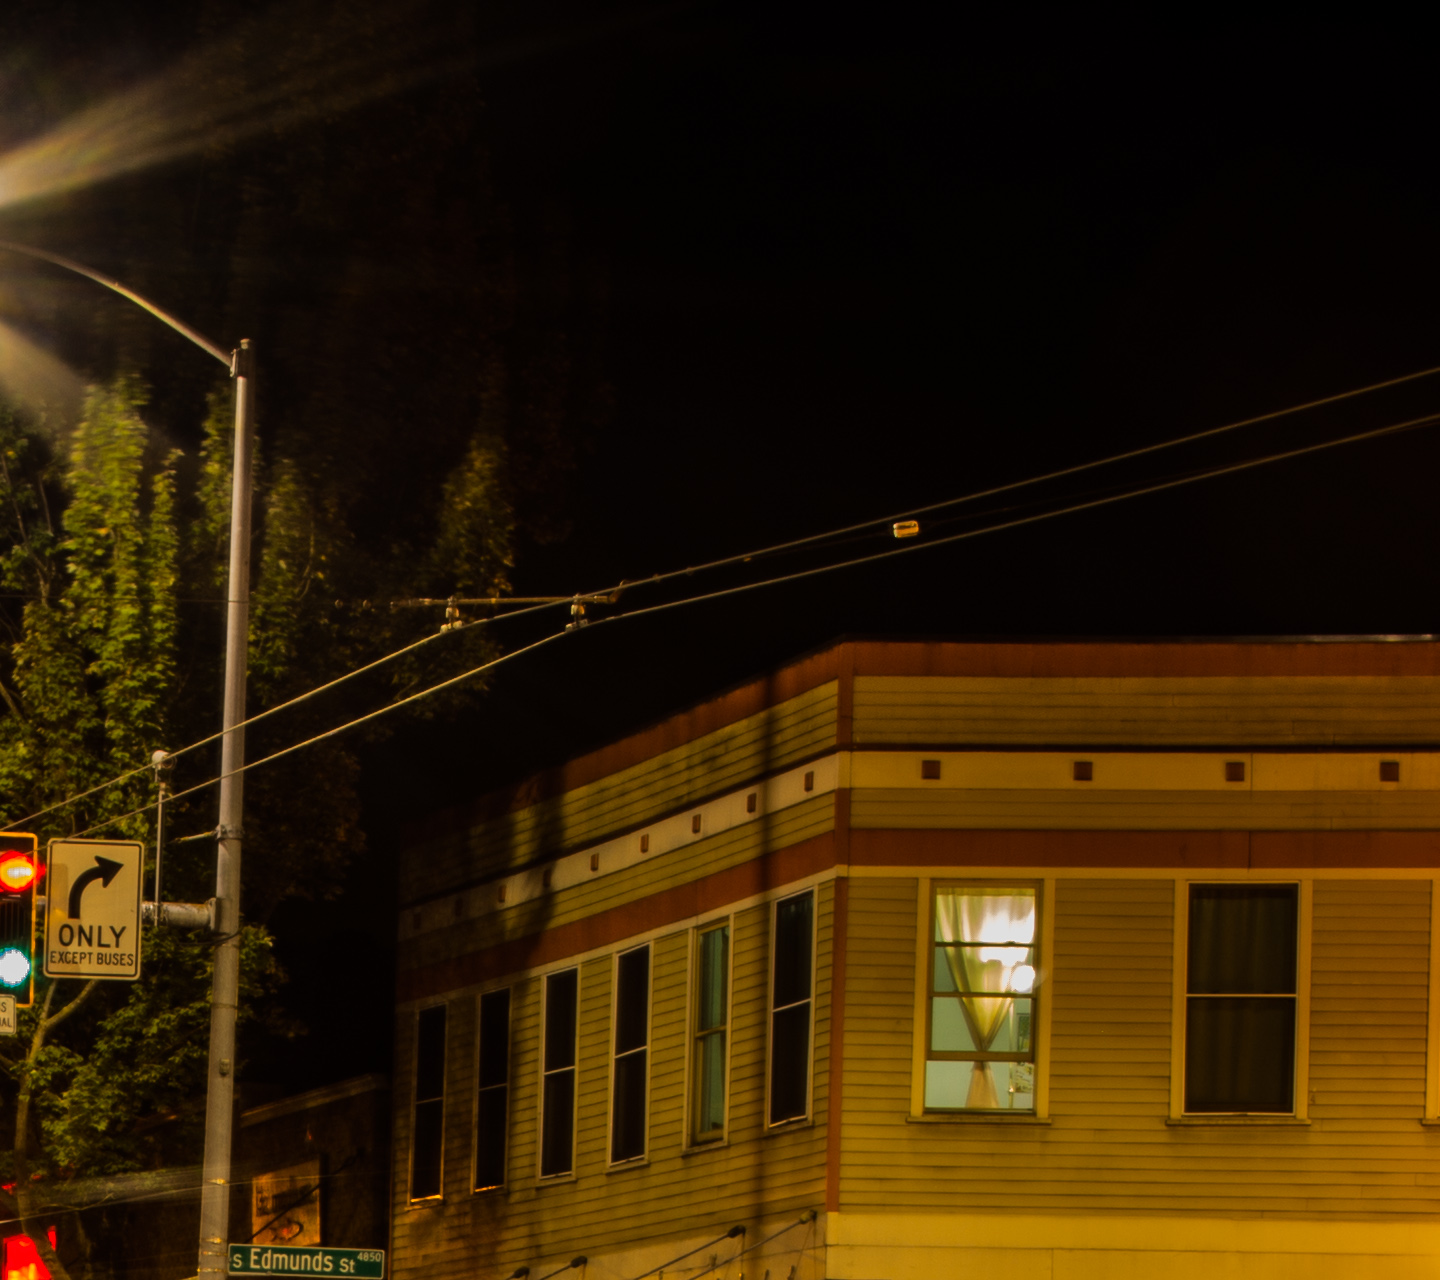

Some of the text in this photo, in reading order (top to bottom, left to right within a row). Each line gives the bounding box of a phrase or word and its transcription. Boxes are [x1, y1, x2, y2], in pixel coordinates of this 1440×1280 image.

[58, 923, 127, 949] ONLY
[49, 950, 135, 967] EXCEPT BUSES
[249, 1247, 334, 1272] Edmunds
[338, 1258, 356, 1274] St
[357, 1252, 382, 1263] 4850
